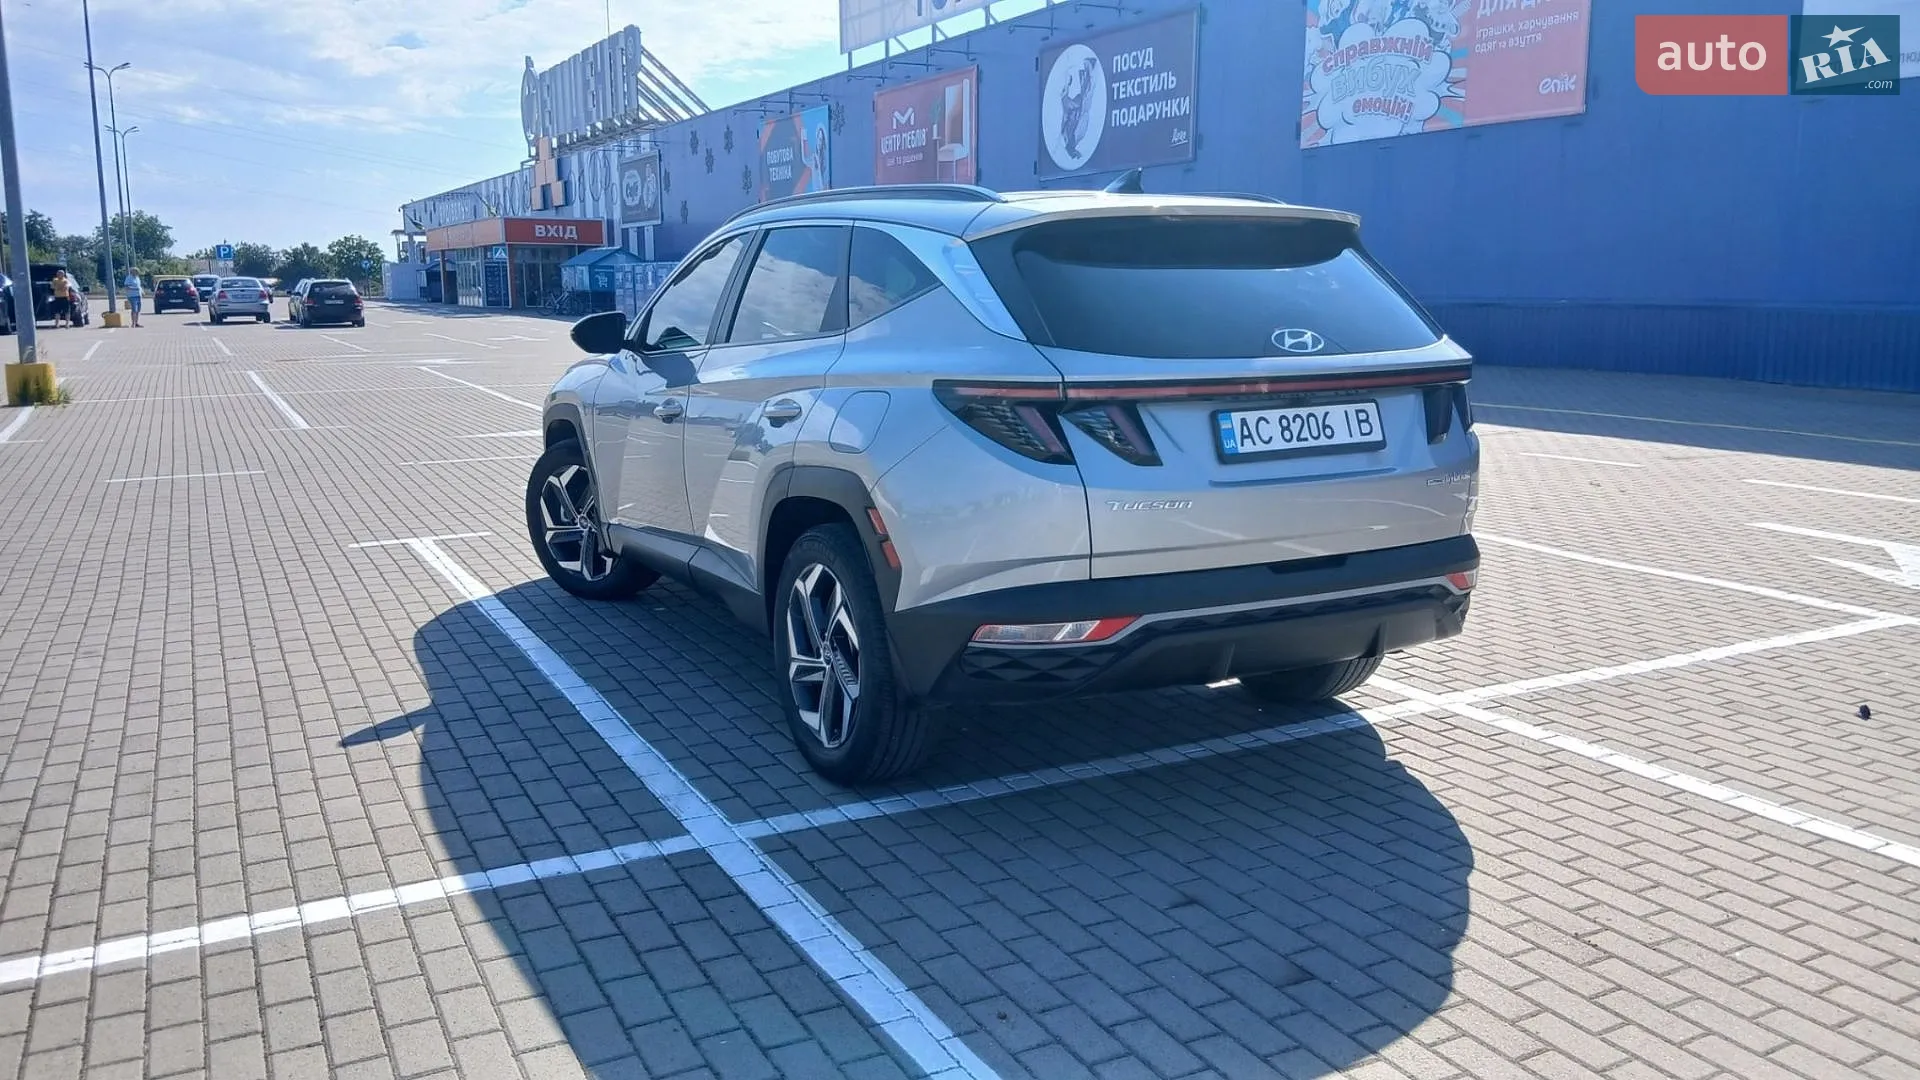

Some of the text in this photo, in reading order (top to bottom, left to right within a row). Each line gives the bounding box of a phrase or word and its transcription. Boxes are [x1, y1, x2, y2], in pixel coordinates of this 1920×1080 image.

[1518, 11, 1580, 31] харчування
[1508, 32, 1543, 48] взуття
[1112, 47, 1154, 74] ПОСУД
[1112, 71, 1177, 101] ТЕКСТИЛЬ
[1111, 96, 1190, 127] ПОДАРУНКИ
[881, 134, 901, 155] ЦЕНТР
[535, 224, 578, 240] ВХІД
[1239, 408, 1374, 448] AC 8206 IB
[1223, 440, 1237, 450] UA
